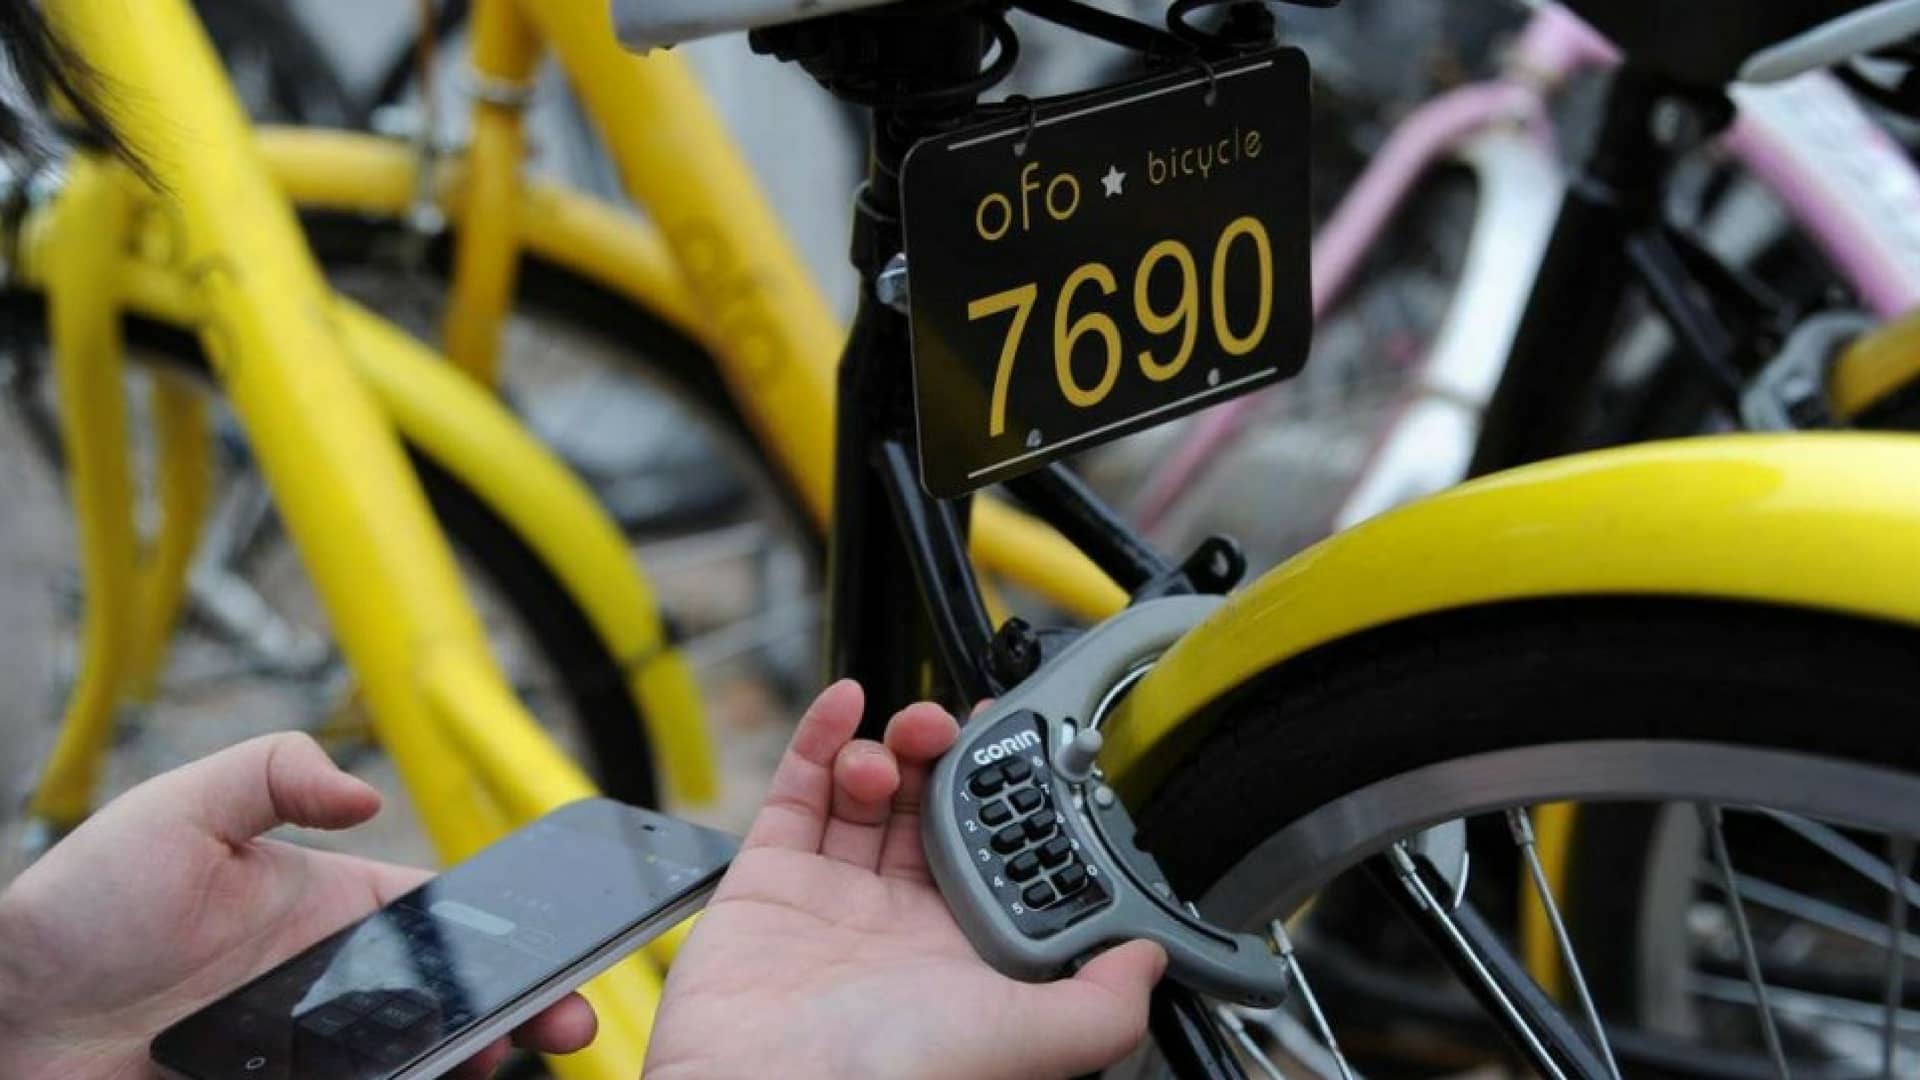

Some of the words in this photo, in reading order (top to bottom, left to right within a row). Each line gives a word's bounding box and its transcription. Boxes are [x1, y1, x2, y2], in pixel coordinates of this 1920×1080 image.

[976, 162, 1080, 240] ofo
[1148, 127, 1262, 185] bicycle
[968, 217, 1273, 437] 7690
[973, 730, 1041, 765] GORIN
